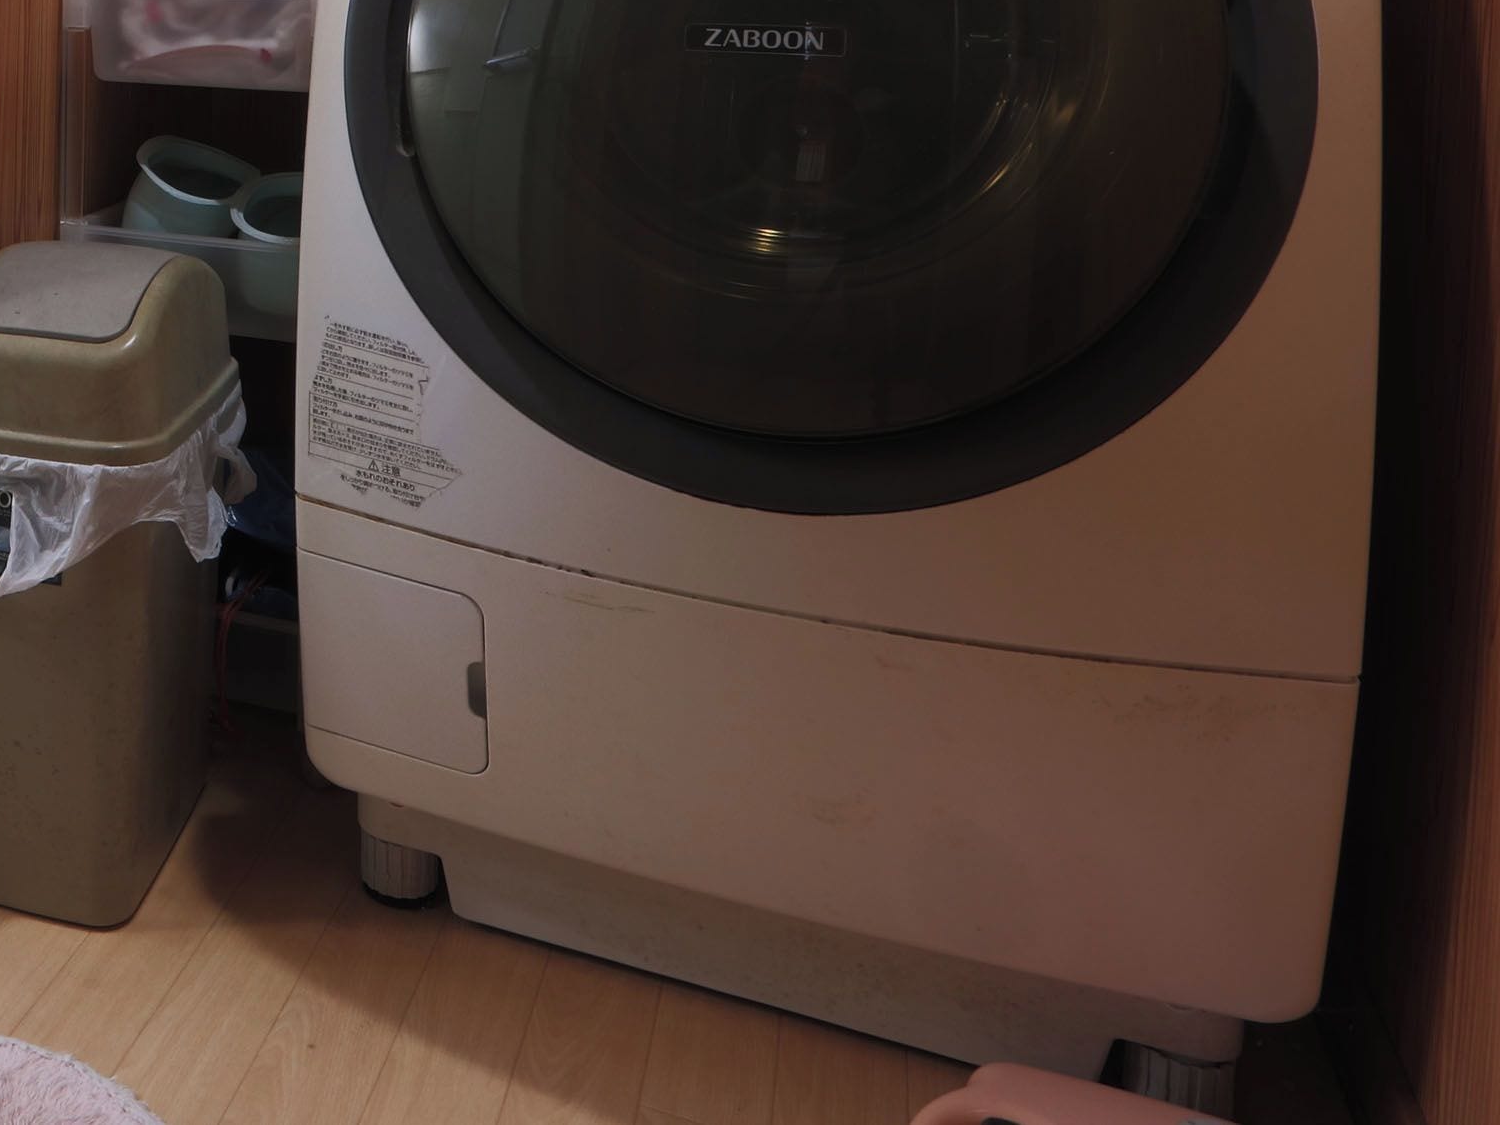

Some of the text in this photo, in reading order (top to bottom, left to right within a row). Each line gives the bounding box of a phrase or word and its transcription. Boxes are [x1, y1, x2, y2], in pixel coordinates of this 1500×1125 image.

[704, 28, 824, 51] ZABOON
[356, 470, 415, 491] 水もれのおそれあり
[381, 464, 401, 476] 注意
